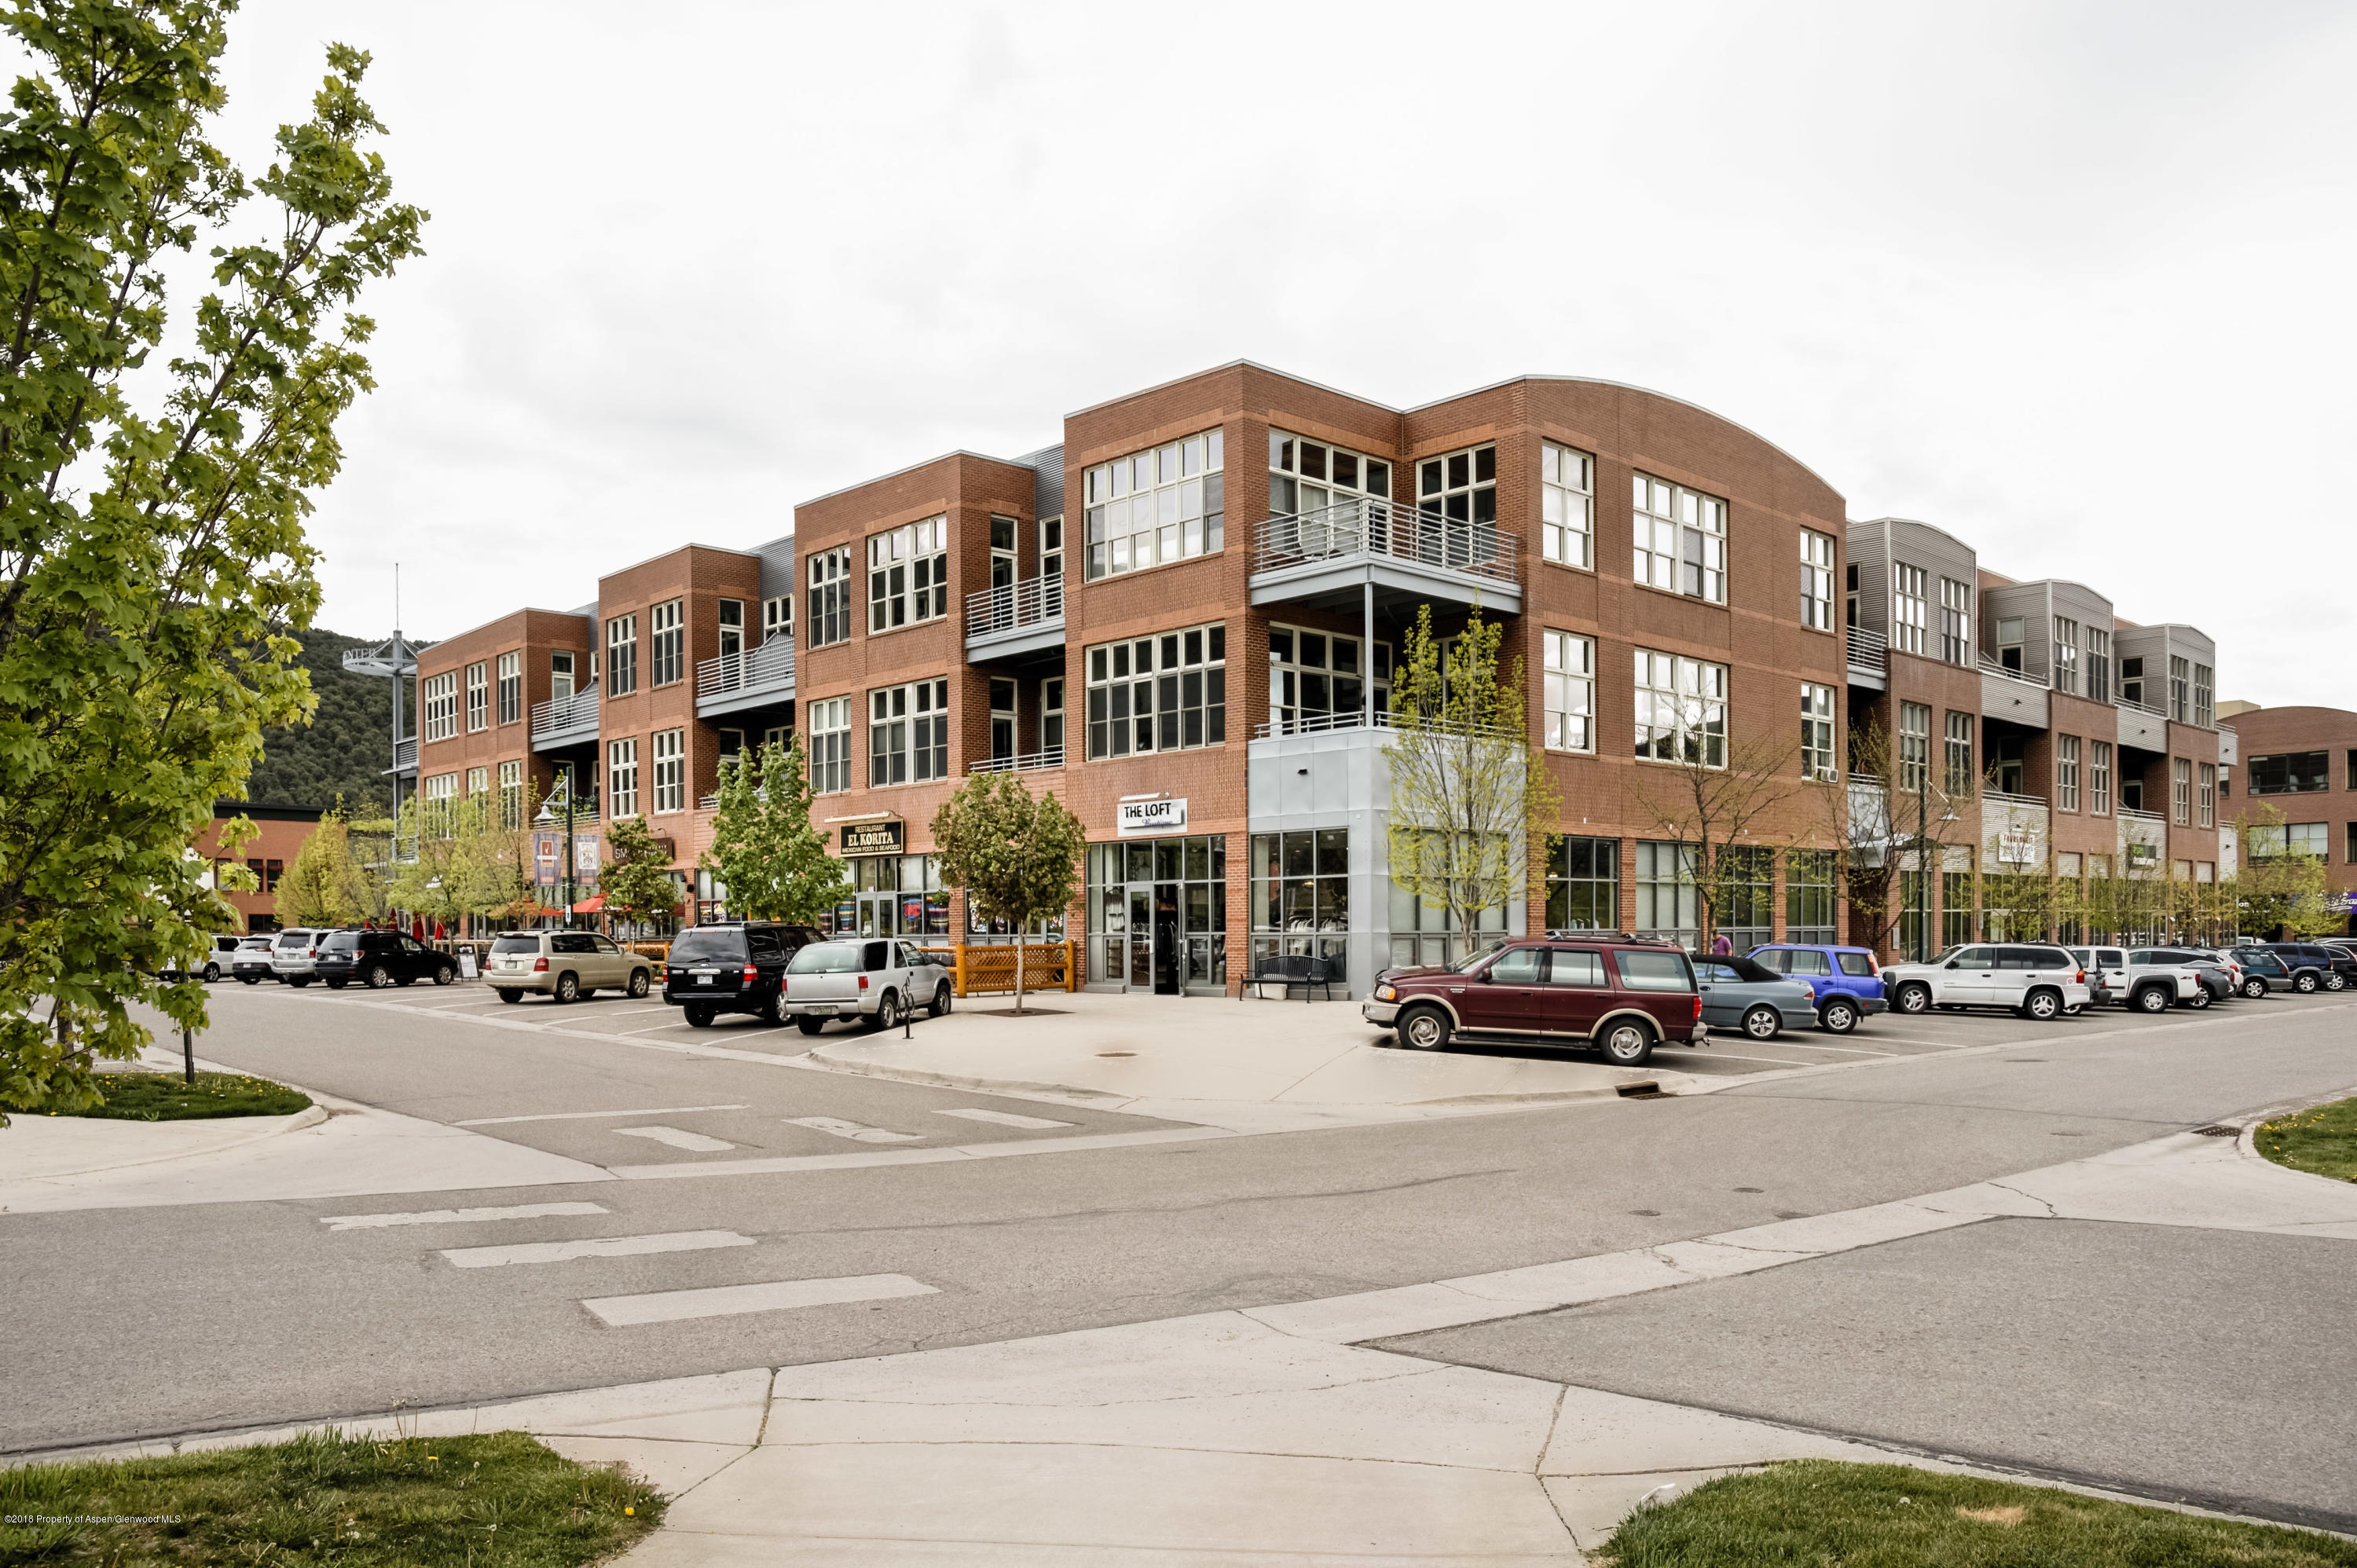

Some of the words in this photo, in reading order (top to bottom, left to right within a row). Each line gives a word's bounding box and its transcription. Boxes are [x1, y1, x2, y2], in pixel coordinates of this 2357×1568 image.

[1124, 805, 1142, 818] THE
[1146, 803, 1171, 816] LOFT
[856, 824, 885, 833] RESTAURANT
[849, 834, 859, 846] EL
[860, 832, 893, 845] KORITA
